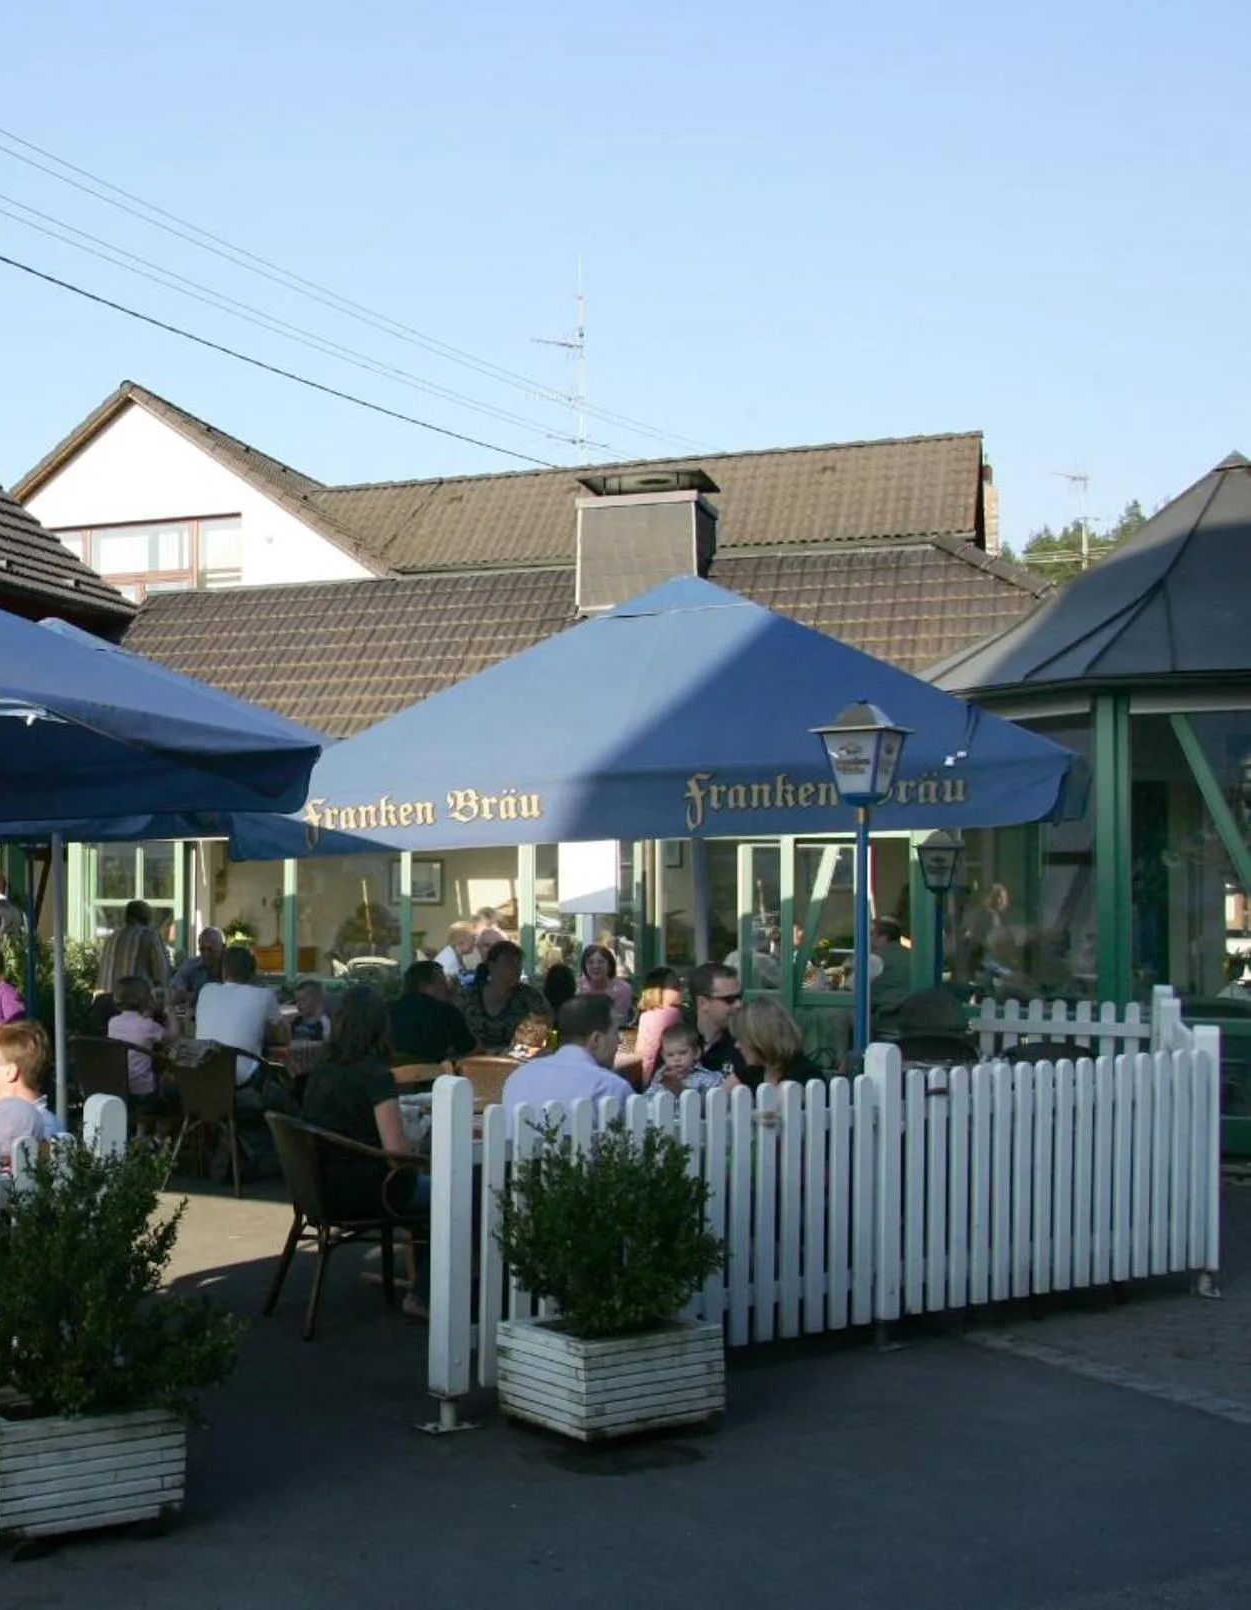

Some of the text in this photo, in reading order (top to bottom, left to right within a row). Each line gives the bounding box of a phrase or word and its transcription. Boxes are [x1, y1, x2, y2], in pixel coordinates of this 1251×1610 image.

[302, 787, 542, 850] Franken Bräu
[684, 772, 968, 831] Franken räu
